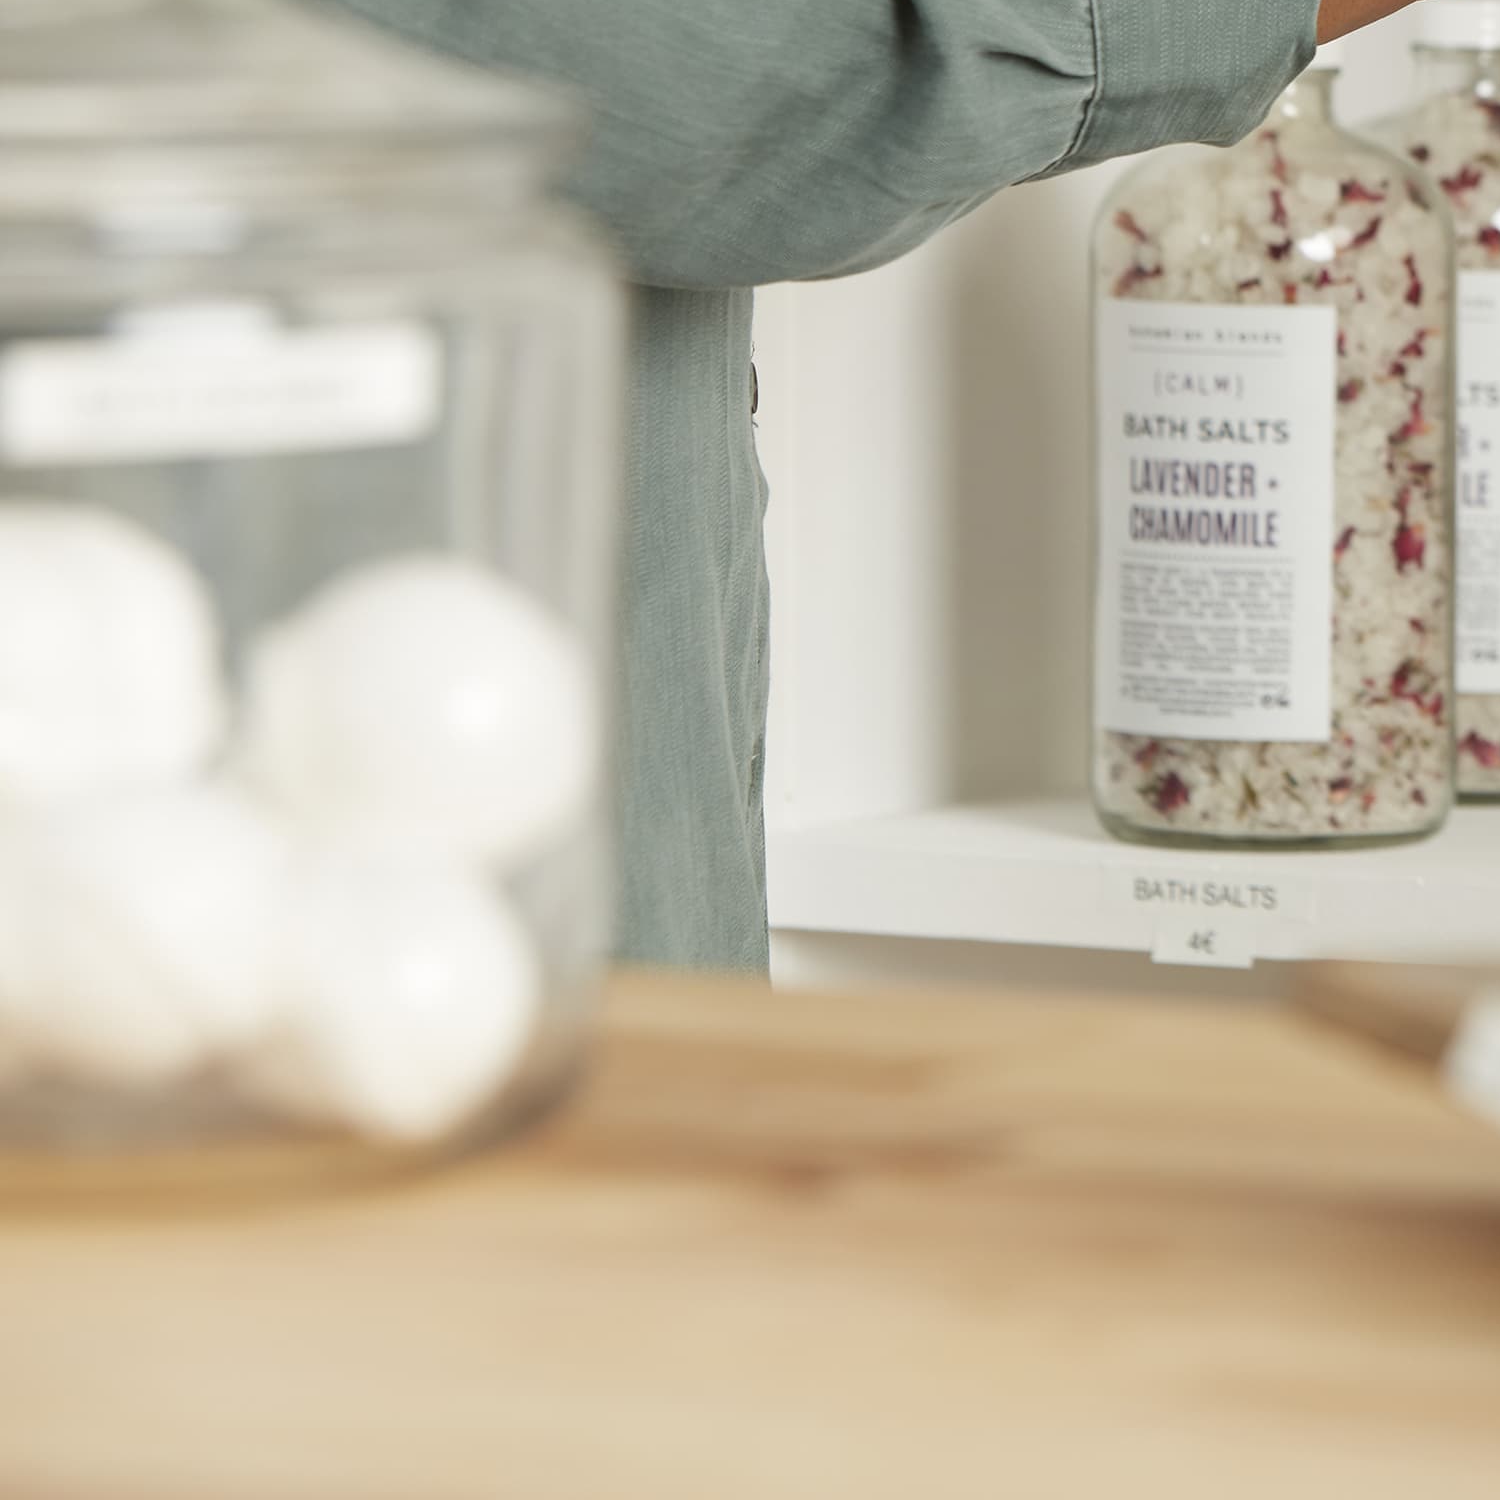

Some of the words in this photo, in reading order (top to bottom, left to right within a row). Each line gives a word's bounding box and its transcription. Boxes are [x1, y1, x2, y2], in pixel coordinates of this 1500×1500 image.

[1123, 411, 1188, 439] BATH
[1198, 416, 1290, 444] SALTS
[1130, 456, 1257, 499] LAVENDER
[1129, 503, 1279, 548] CHAMOMILE
[1133, 877, 1197, 904] BATH
[1202, 882, 1278, 911] SALTS
